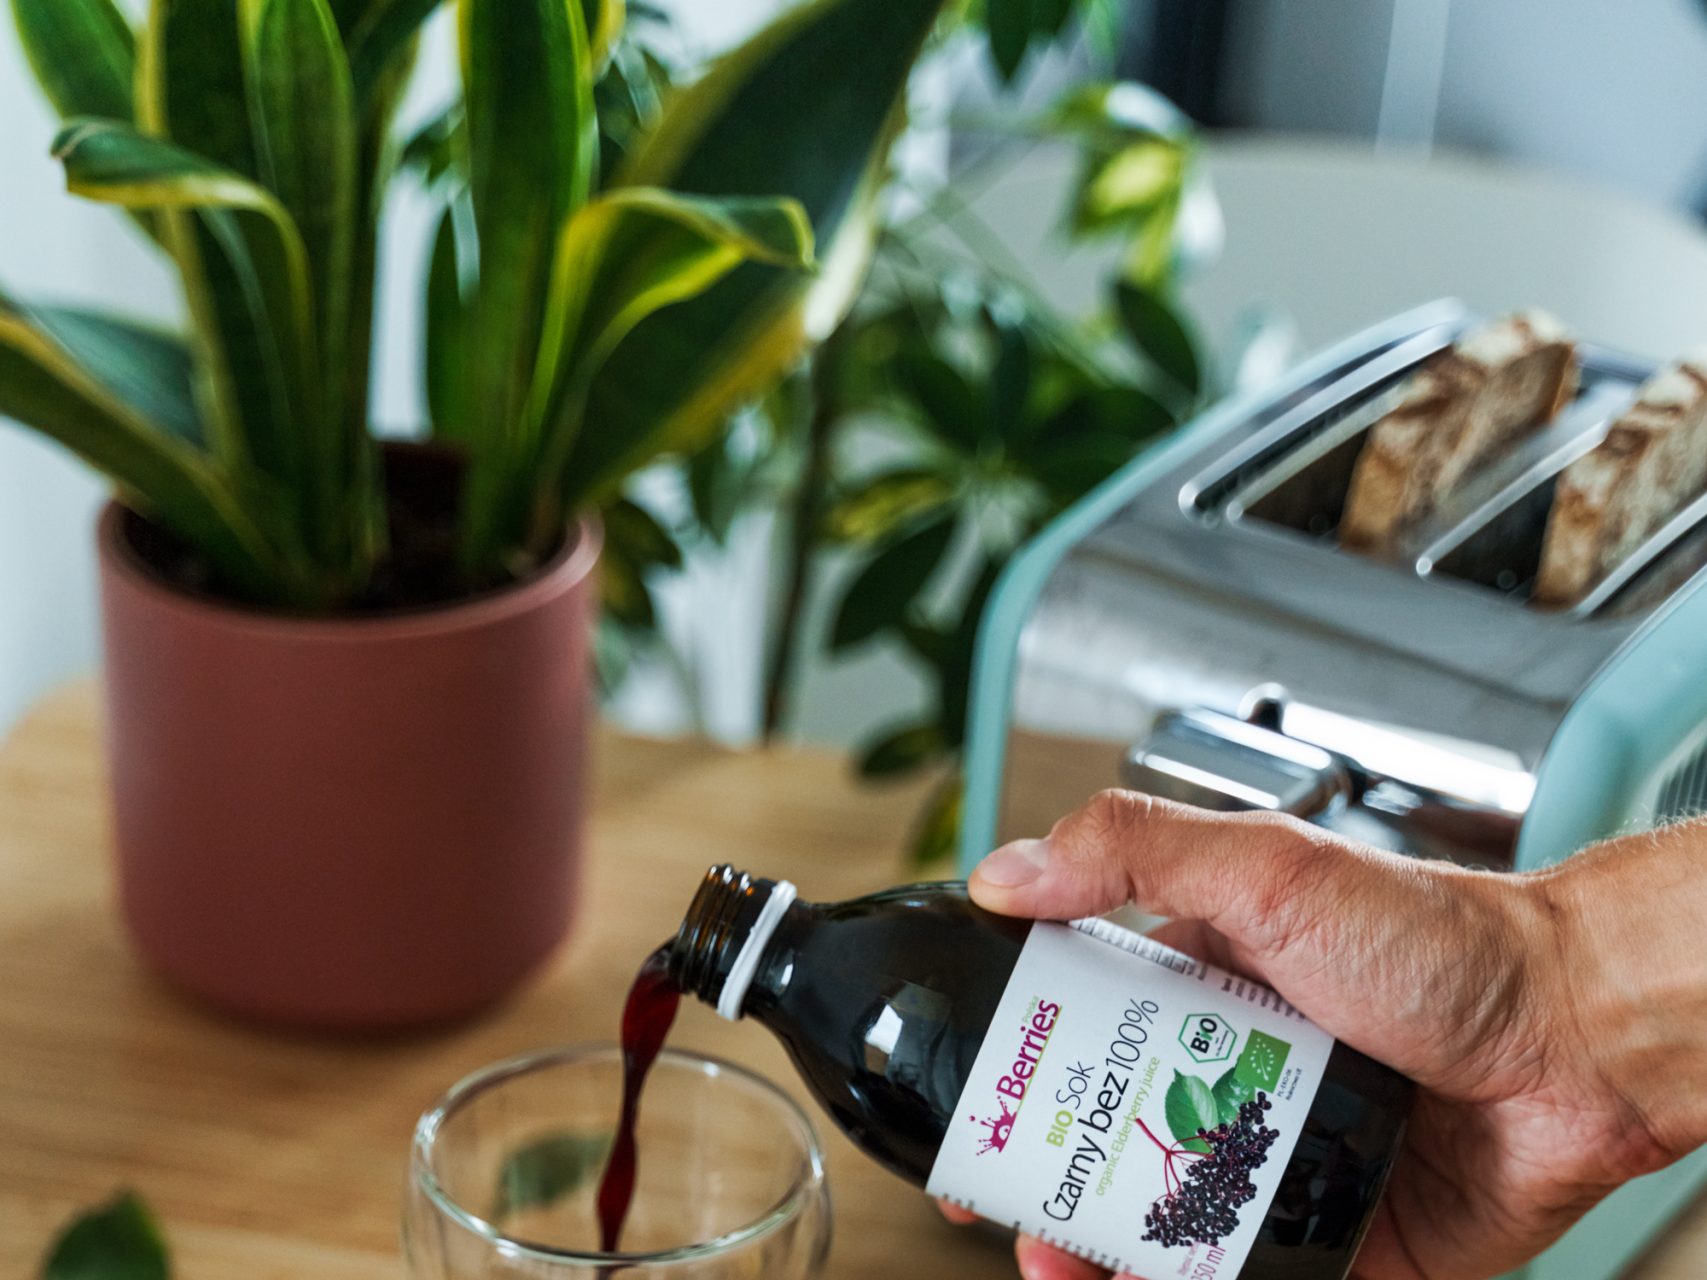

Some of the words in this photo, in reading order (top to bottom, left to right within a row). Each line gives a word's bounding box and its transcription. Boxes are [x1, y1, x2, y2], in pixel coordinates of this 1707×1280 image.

[996, 1000, 1060, 1100] Berries
[1056, 1061, 1095, 1110] Sok
[1043, 1133, 1107, 1221] Czarny
[1077, 1071, 1129, 1133] bez
[1105, 998, 1160, 1071] 100%
[1046, 1109, 1073, 1147] BIO
[1096, 1153, 1120, 1196] organic
[1111, 1088, 1150, 1153] Elderberry
[1140, 1056, 1160, 1089] juice
[1204, 1241, 1227, 1265] ml
